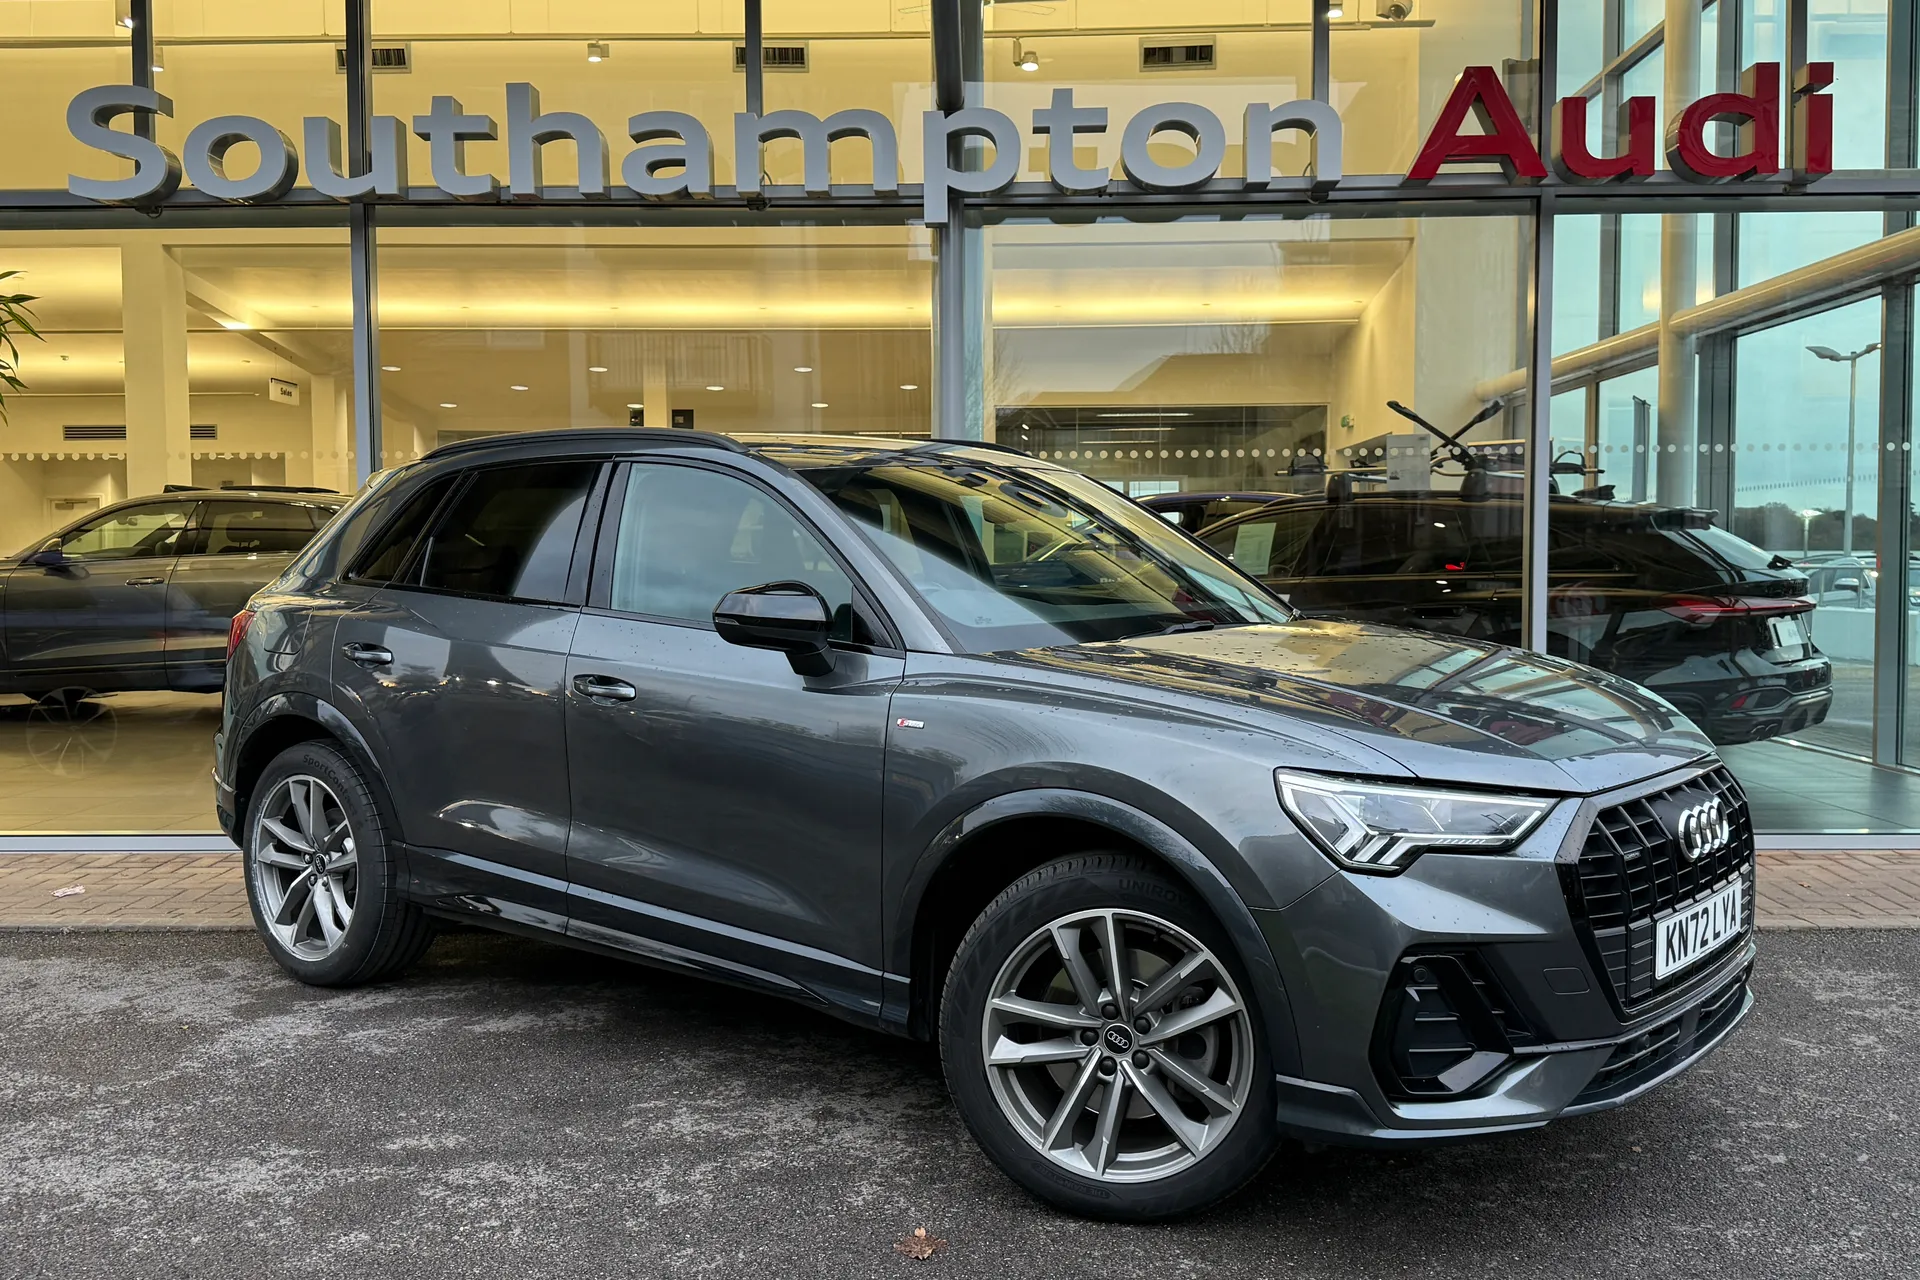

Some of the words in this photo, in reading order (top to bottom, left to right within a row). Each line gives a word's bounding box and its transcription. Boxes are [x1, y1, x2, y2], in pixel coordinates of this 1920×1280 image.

[67, 82, 1343, 227] Southampton
[1401, 61, 1835, 186] Audi
[1665, 907, 1709, 968] KN72
[1713, 890, 1736, 941] LYA
